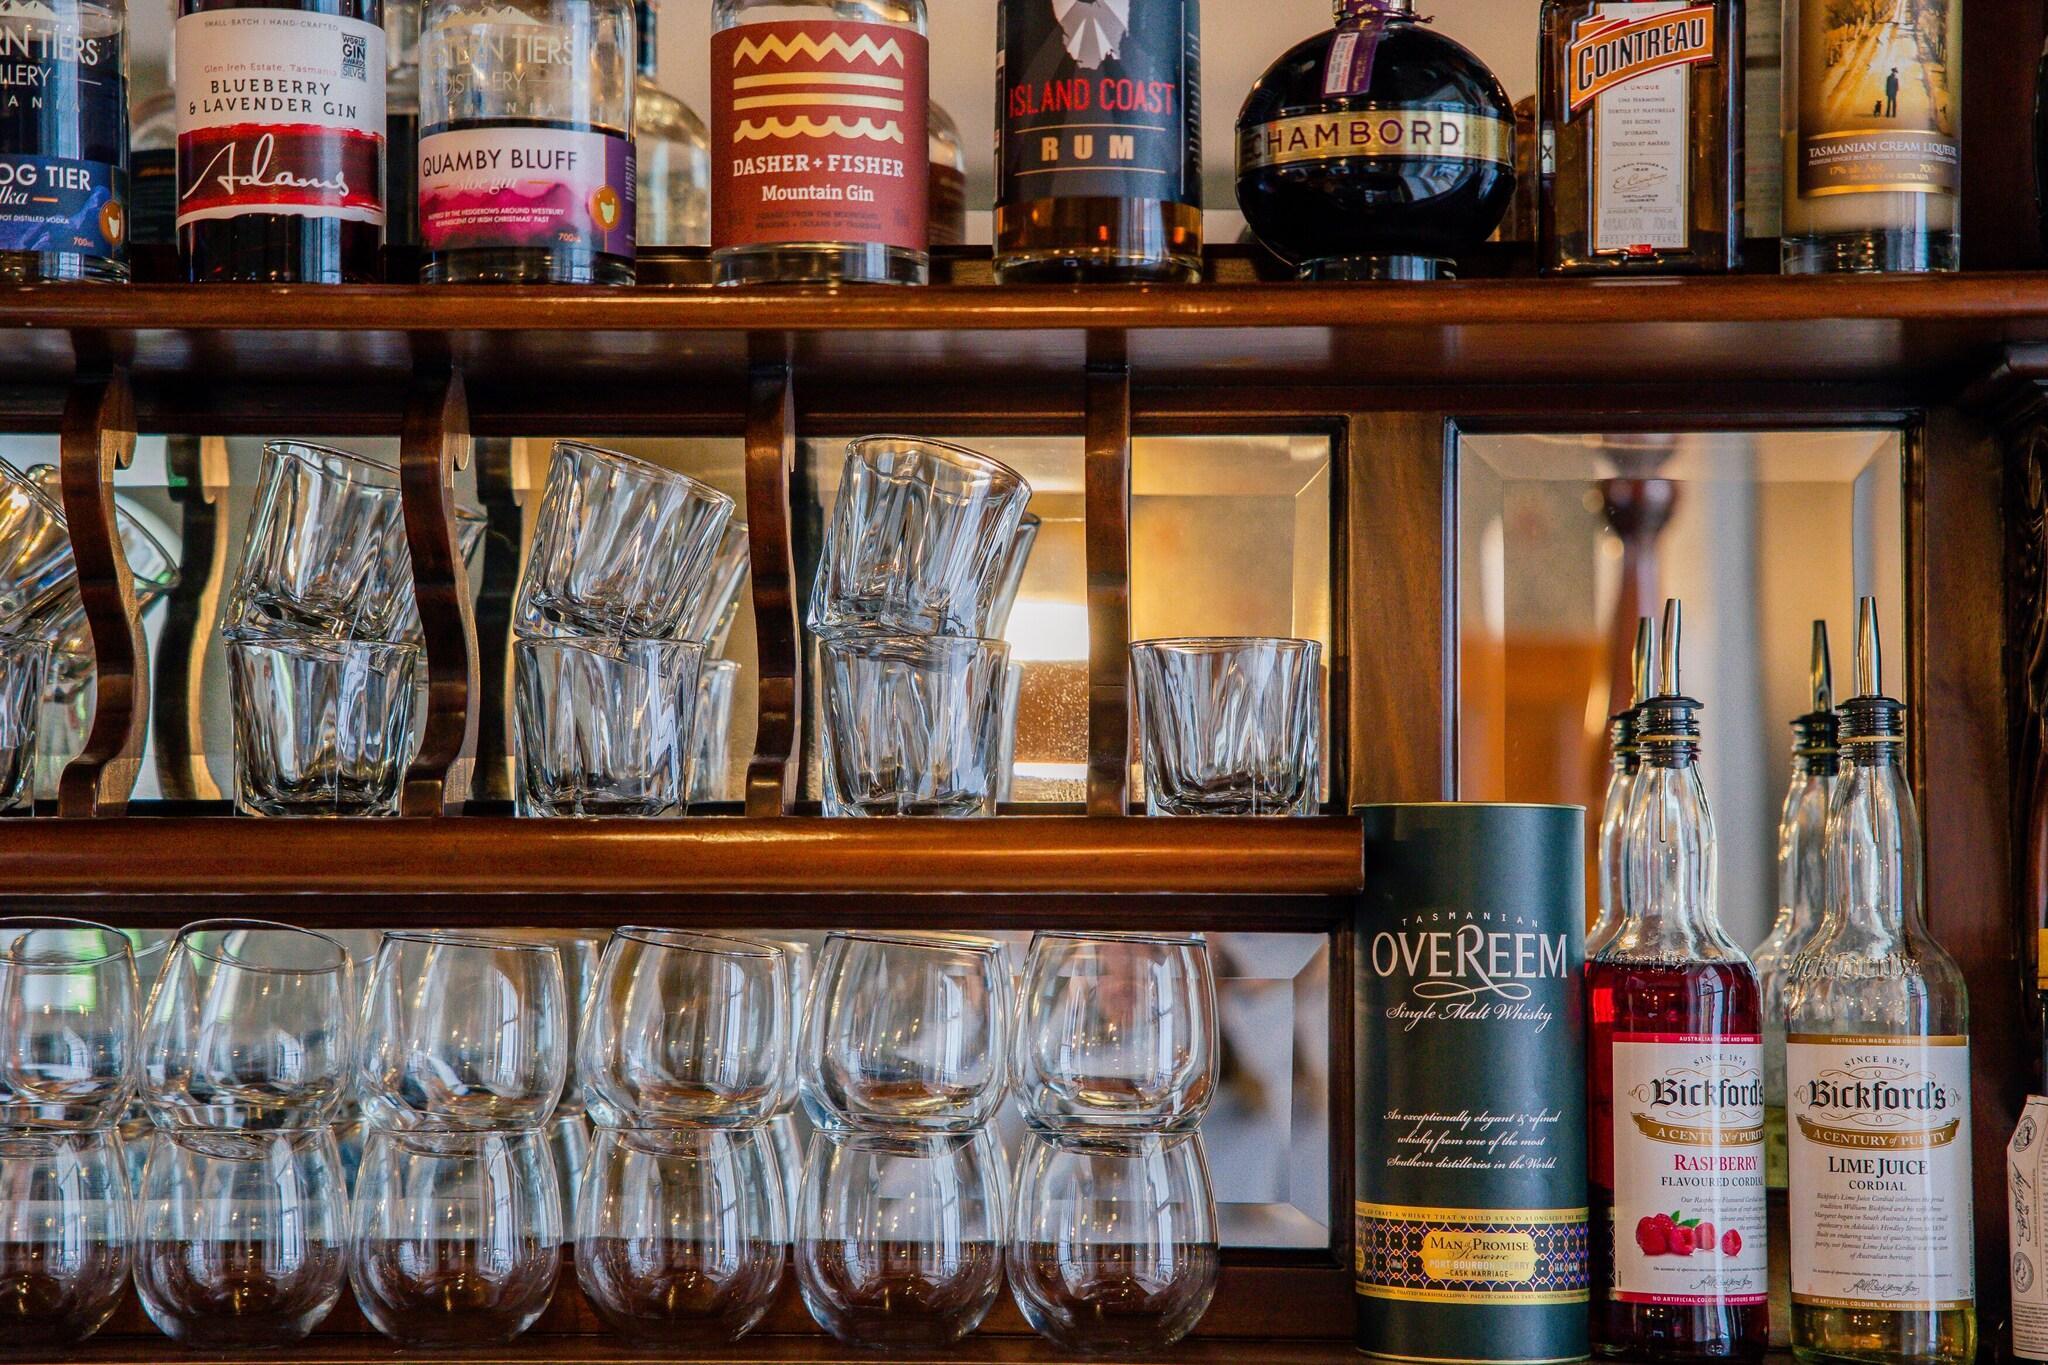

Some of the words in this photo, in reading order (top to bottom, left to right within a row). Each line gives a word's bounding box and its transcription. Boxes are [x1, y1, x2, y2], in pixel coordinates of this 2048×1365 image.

[204, 20, 228, 28] SMALL
[231, 18, 260, 26] BATCH
[37, 29, 98, 66] TIERS
[342, 43, 366, 61] GIN
[512, 33, 574, 65] TIERS
[1578, 18, 1706, 91] COINTREAU
[204, 65, 223, 73] Glen
[211, 79, 331, 97] BLUEBERRY
[1009, 79, 1090, 118] ISLAND
[1099, 78, 1175, 115] COAST
[203, 97, 313, 114] LAVENDER
[323, 101, 357, 119] GIN
[1041, 135, 1134, 162] RUM
[1809, 142, 1876, 158] TASMANIAN
[1880, 141, 1921, 151] CREAM
[182, 132, 350, 201] Adams
[422, 149, 502, 177] QUAMBY
[511, 149, 577, 171] BLUFF
[733, 154, 810, 176] DASHER
[828, 154, 904, 177] FISHER
[45, 165, 91, 191] TIER
[489, 176, 519, 195] gin
[762, 184, 842, 202] Mountain
[846, 184, 875, 202] Gin
[13, 214, 45, 223] DISTILLED
[46, 217, 70, 225] VODKA
[461, 207, 499, 216] HEDGEROWS
[501, 206, 529, 214] AROUND
[531, 207, 565, 216] WESTBURY
[534, 215, 550, 223] PAST
[1401, 911, 1539, 928] TASMANIAN
[1372, 924, 1568, 985] OVEREEM
[1386, 1002, 1436, 1032] Single
[1439, 1002, 1490, 1020] Malt
[1494, 1003, 1553, 1033] Whisky
[1844, 1055, 1880, 1068] SINCE
[1886, 1055, 1911, 1069] 1874
[1808, 1079, 1947, 1110] Bickford's
[1384, 1108, 1401, 1120] An
[1403, 1110, 1472, 1131] exceptionally
[1474, 1111, 1514, 1131] elegant
[1517, 1113, 1529, 1126] &
[1529, 1108, 1562, 1131] refined
[1656, 1128, 1665, 1137] A
[1814, 1129, 1821, 1139] A
[1823, 1132, 1890, 1146] CENTURY
[1889, 1137, 1899, 1147] of
[1397, 1130, 1433, 1153] whisky
[1431, 1130, 1463, 1153] from
[1466, 1138, 1486, 1146] one
[1488, 1131, 1505, 1155] of
[1502, 1131, 1518, 1146] the
[1521, 1136, 1546, 1146] most
[1386, 1153, 1433, 1167] Southern
[1436, 1156, 1491, 1169] distilleries
[1494, 1158, 1506, 1169] in
[1509, 1157, 1526, 1169] the
[1828, 1156, 1875, 1174] LIME
[1876, 1158, 1928, 1178] JUICE
[1848, 1180, 1907, 1191] CORDIAL
[1841, 1193, 1855, 1201] Lime
[1856, 1193, 1870, 1203] Juice
[1843, 1203, 1866, 1211] William
[1868, 1204, 1892, 1212] Bickford
[1863, 1213, 1880, 1221] South
[1881, 1214, 1907, 1222] Australia
[1473, 1238, 1529, 1251] PROMISE
[1879, 1241, 1894, 1250] Juice
[1453, 1261, 1494, 1270] BOURBON
[1856, 1253, 1888, 1261] Australian
[1450, 1269, 1469, 1277] CASK
[1471, 1270, 1508, 1278] MARRIAGE
